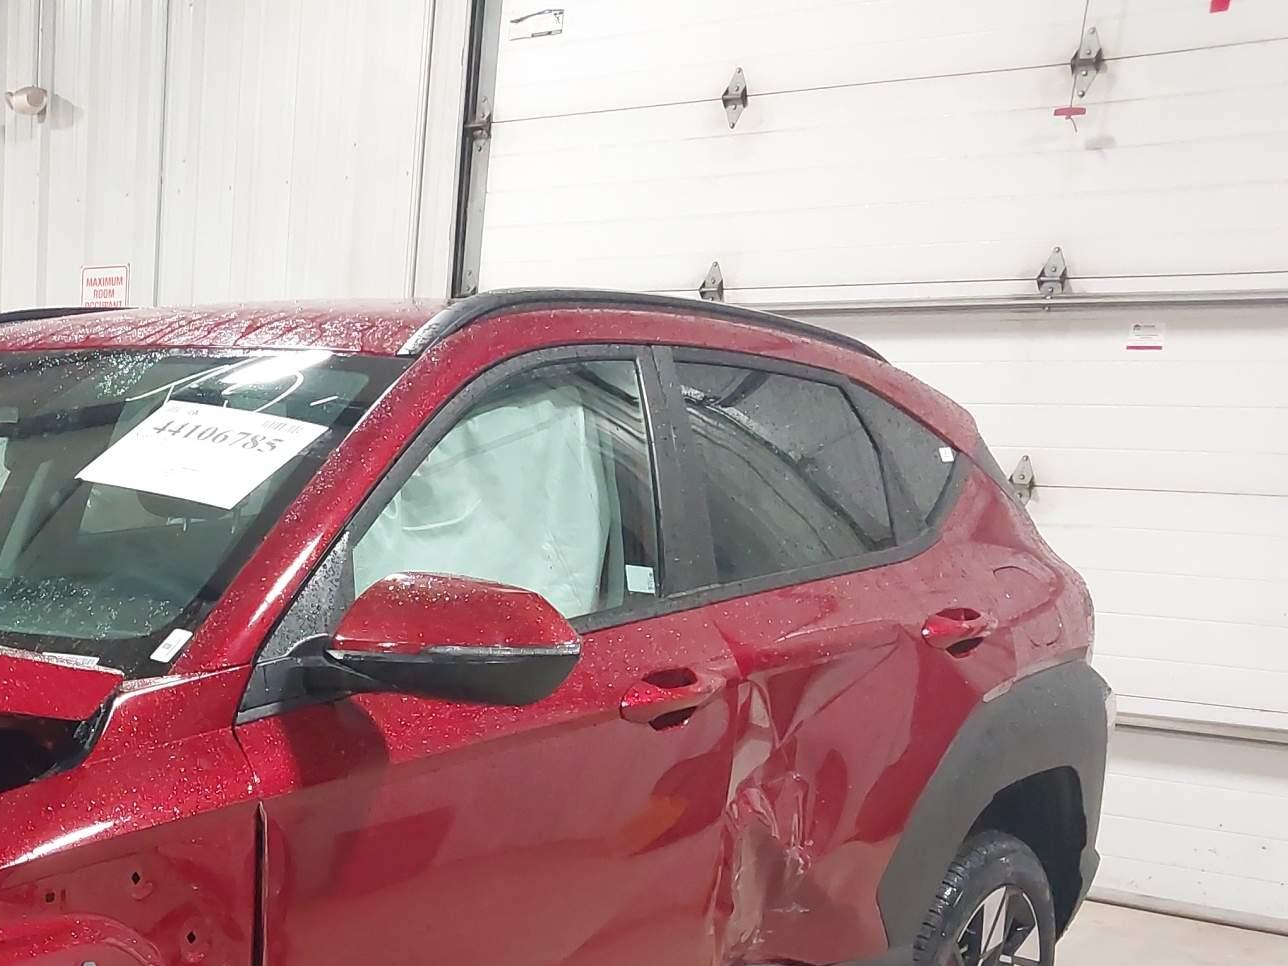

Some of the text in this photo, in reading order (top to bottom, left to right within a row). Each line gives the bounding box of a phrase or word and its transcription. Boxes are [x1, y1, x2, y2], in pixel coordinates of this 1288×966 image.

[86, 276, 123, 287] MAXIMUM
[93, 288, 115, 299] ROOM
[153, 420, 284, 453] 44106785
